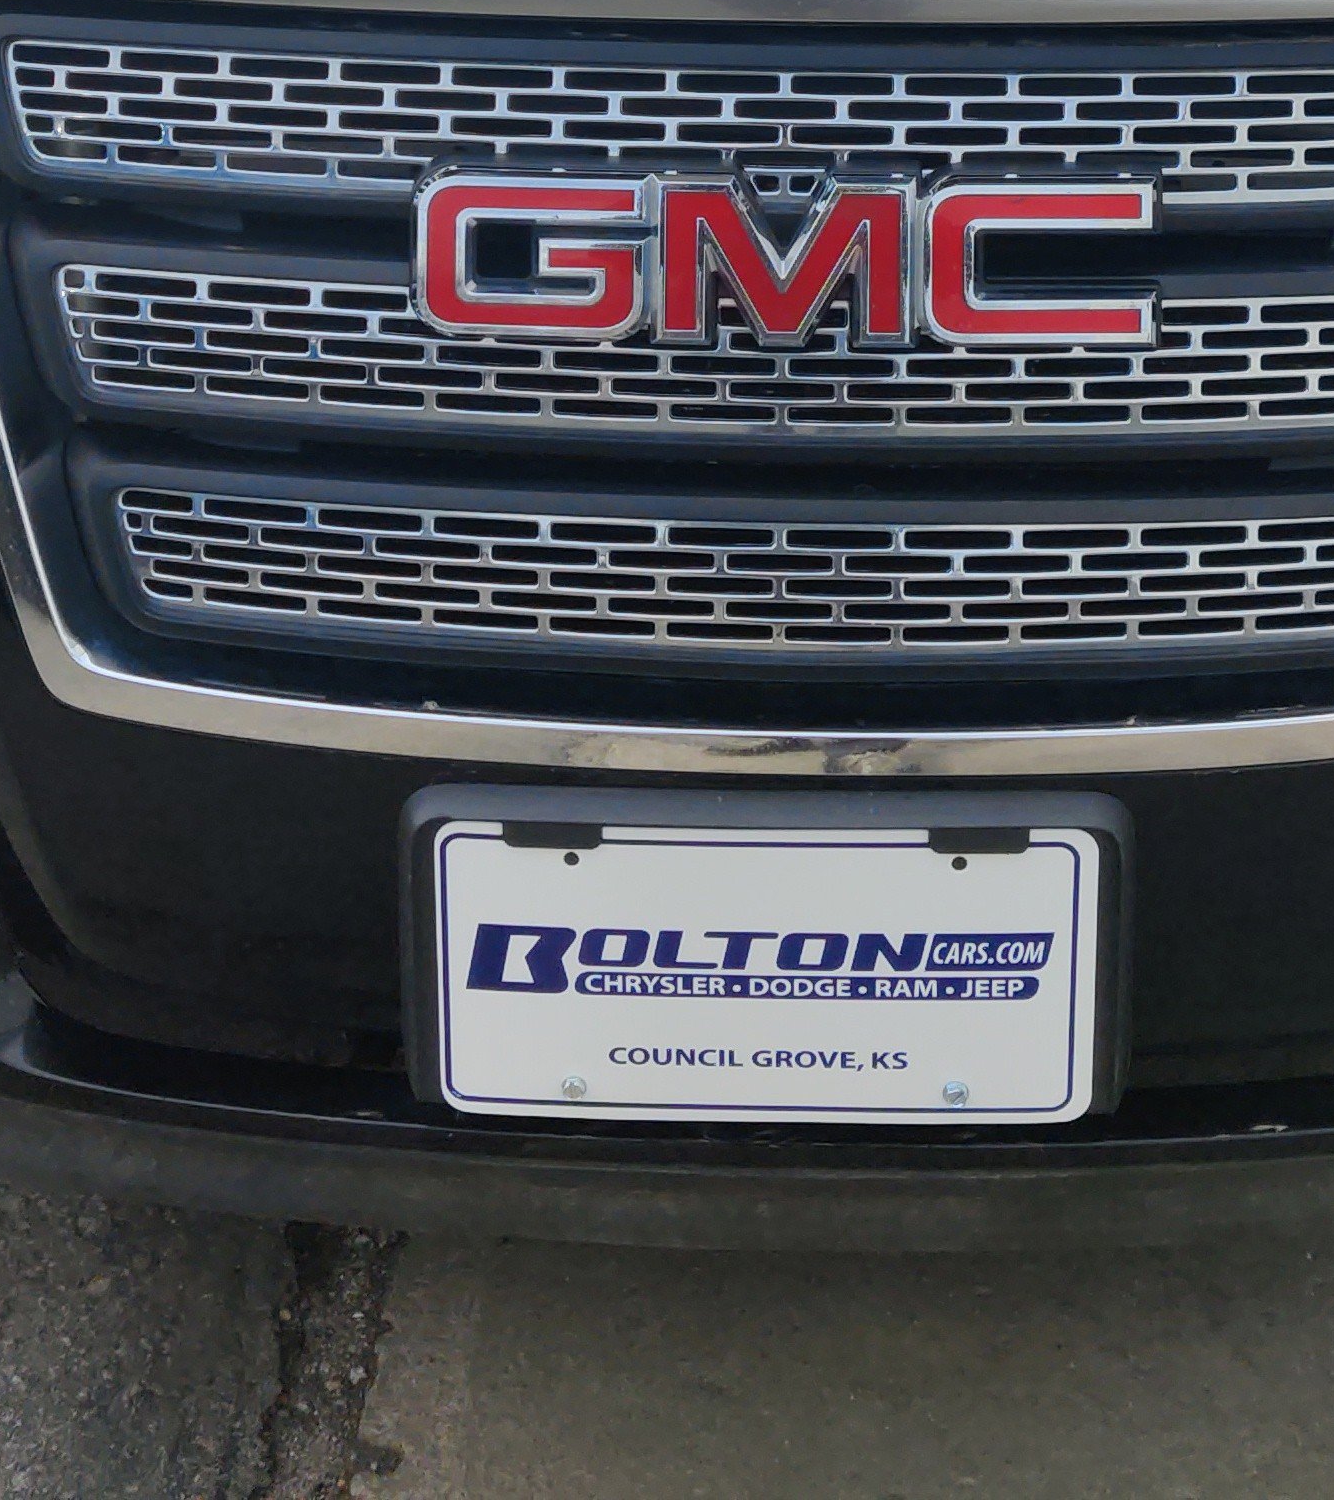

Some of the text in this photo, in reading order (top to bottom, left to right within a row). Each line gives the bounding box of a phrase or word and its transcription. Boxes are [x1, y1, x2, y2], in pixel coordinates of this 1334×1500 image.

[413, 172, 1157, 348] GMC
[466, 923, 1046, 994] BOLTON CARS.COM
[584, 974, 1025, 998] CHRYSLER DODGE RAM JEEP
[608, 1047, 908, 1072] COUNCIL GROVE, KS
